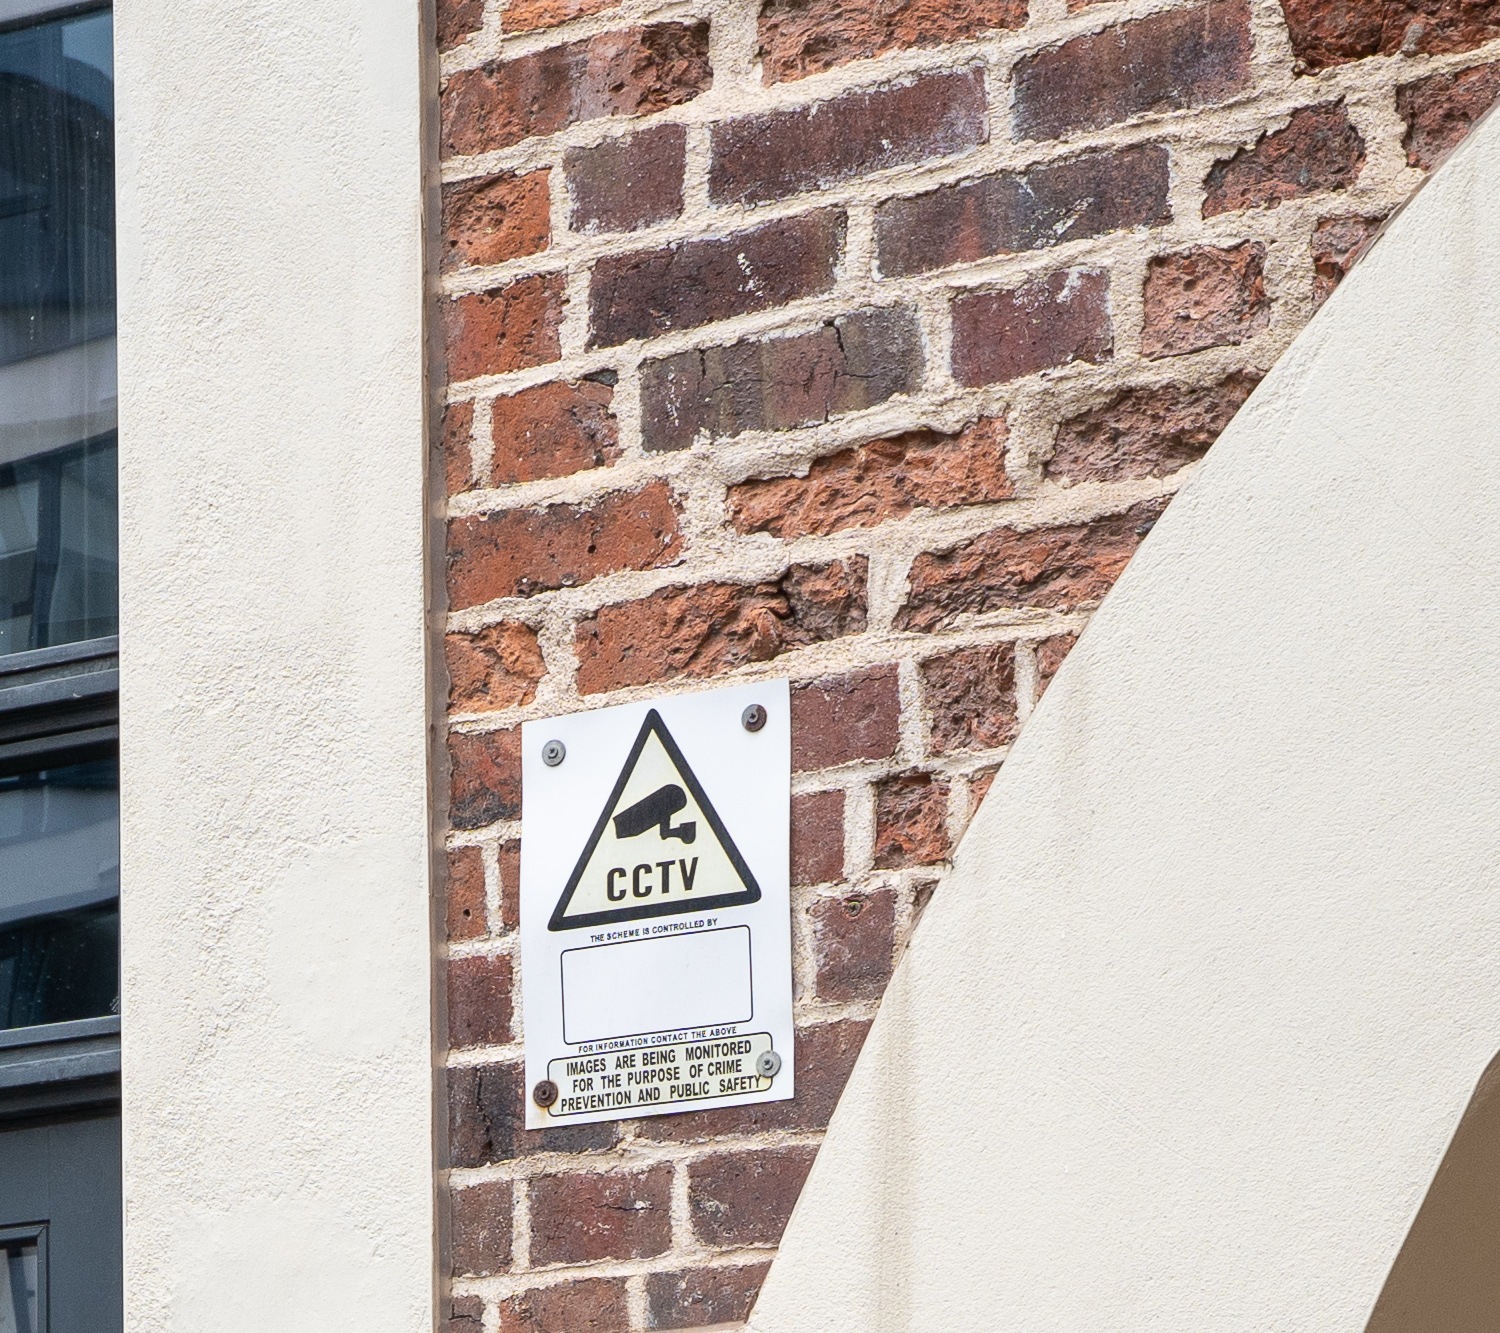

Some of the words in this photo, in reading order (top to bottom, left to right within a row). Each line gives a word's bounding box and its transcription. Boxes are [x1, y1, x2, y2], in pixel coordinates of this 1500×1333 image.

[606, 857, 699, 902] CCTV
[590, 934, 605, 943] THE
[607, 928, 640, 941] SCHEME
[643, 927, 650, 936] IS
[652, 919, 704, 934] CONTROLLED
[707, 918, 718, 926] BY
[578, 1045, 588, 1054] FOR
[595, 1037, 648, 1052] INFORMATION
[651, 1032, 688, 1044] CONTACT
[691, 1030, 706, 1039] THE
[710, 1026, 737, 1037] ABOVE
[566, 1058, 606, 1076] IMAGES
[615, 1054, 636, 1070] ARE
[642, 1049, 676, 1066] BEING
[685, 1040, 751, 1062] MONITORED
[561, 1092, 631, 1112] PREVENTION
[638, 1086, 660, 1102] AND
[670, 1081, 710, 1099] PUBLIC
[719, 1074, 761, 1093] SAFETY
[573, 1077, 593, 1093] FOR
[600, 1074, 621, 1090] THE
[627, 1066, 680, 1086] PURPOSE
[689, 1063, 703, 1078] OF
[707, 1059, 742, 1076] CRIME
